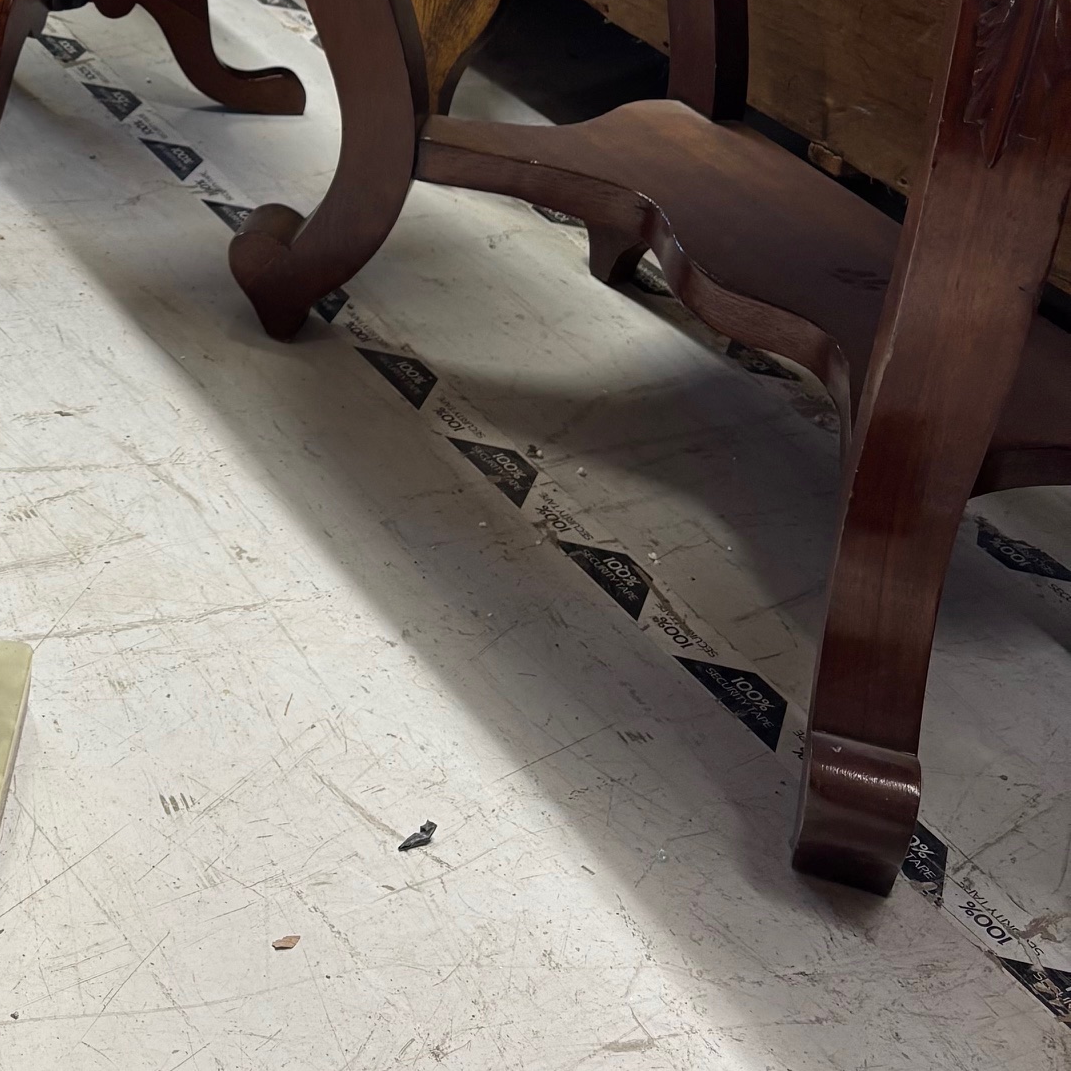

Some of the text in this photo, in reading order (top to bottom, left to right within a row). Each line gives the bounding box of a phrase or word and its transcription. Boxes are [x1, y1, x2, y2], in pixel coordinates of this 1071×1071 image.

[396, 361, 428, 385] 100%
[433, 407, 465, 432] 100%
[492, 452, 528, 479] 100%
[535, 505, 572, 533] 100%
[583, 548, 639, 602] SECURITY TAPE
[602, 556, 641, 587] 100%
[657, 616, 694, 649] 100%
[705, 667, 775, 729] SECURITY TAPE
[730, 676, 775, 712] 100%
[905, 851, 937, 880] TAPE
[958, 901, 1013, 946] 100%
